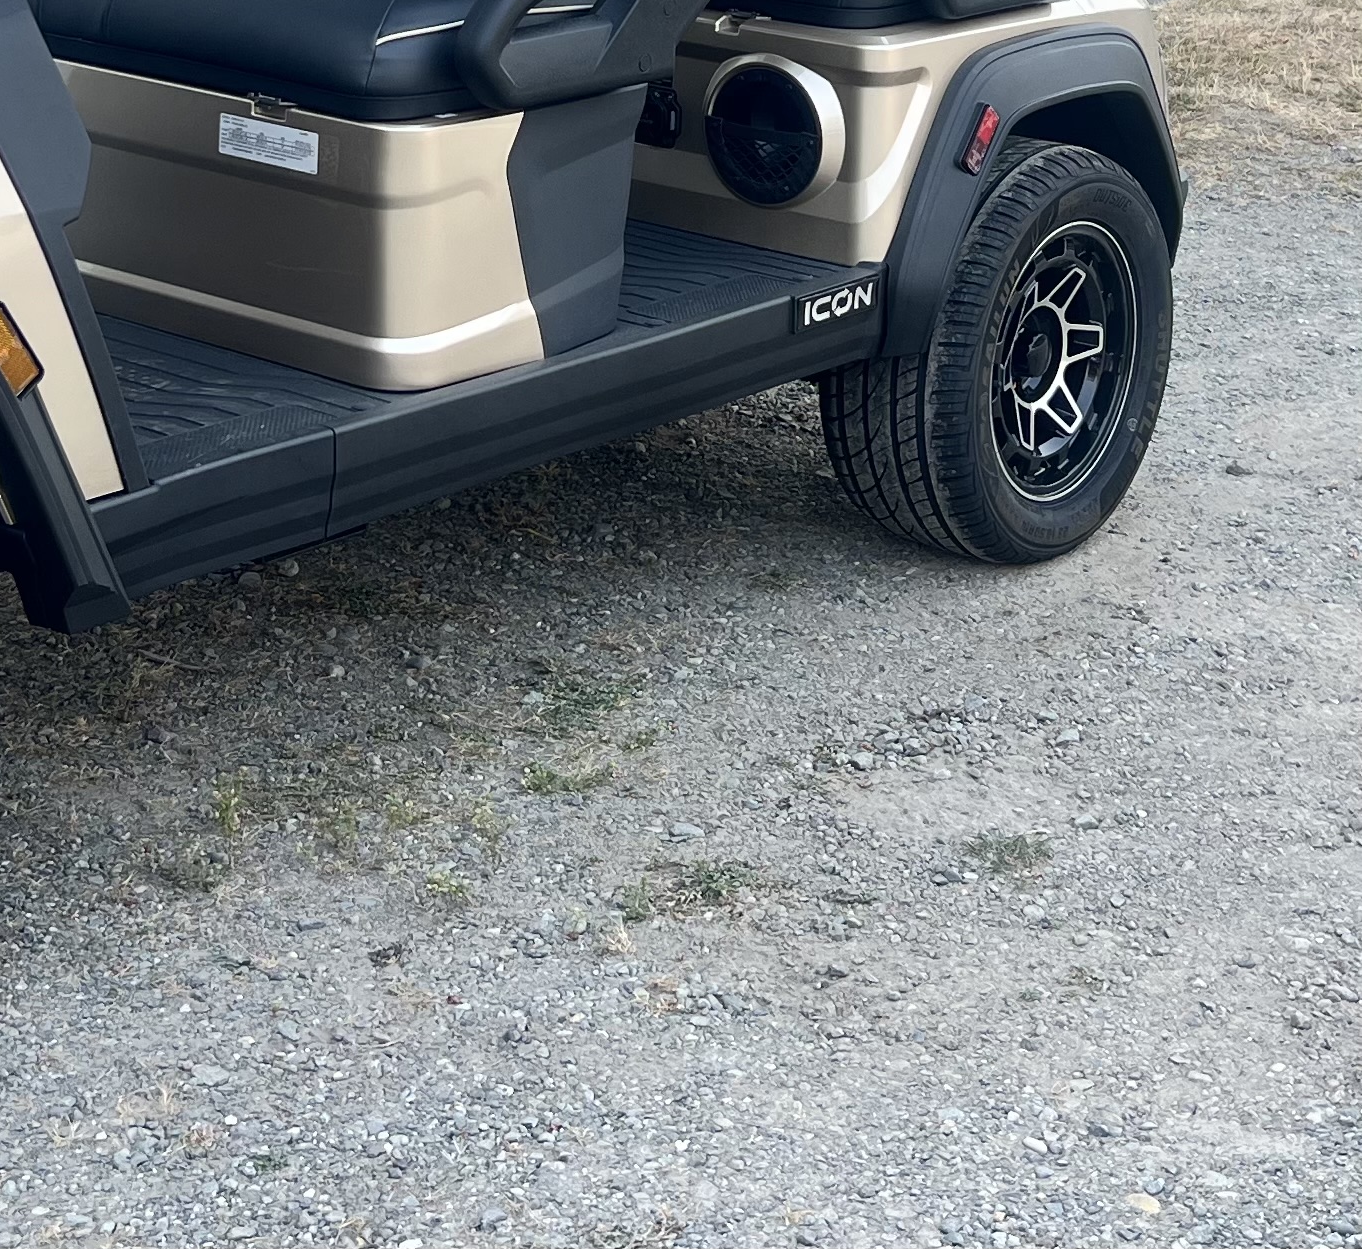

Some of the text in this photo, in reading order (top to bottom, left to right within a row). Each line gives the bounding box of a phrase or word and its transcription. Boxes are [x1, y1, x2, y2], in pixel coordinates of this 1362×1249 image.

[1093, 188, 1133, 212] OUTSIDE
[804, 282, 873, 326] ICON
[983, 258, 1020, 386] SAILUN
[1131, 312, 1168, 459] SHUTTLE
